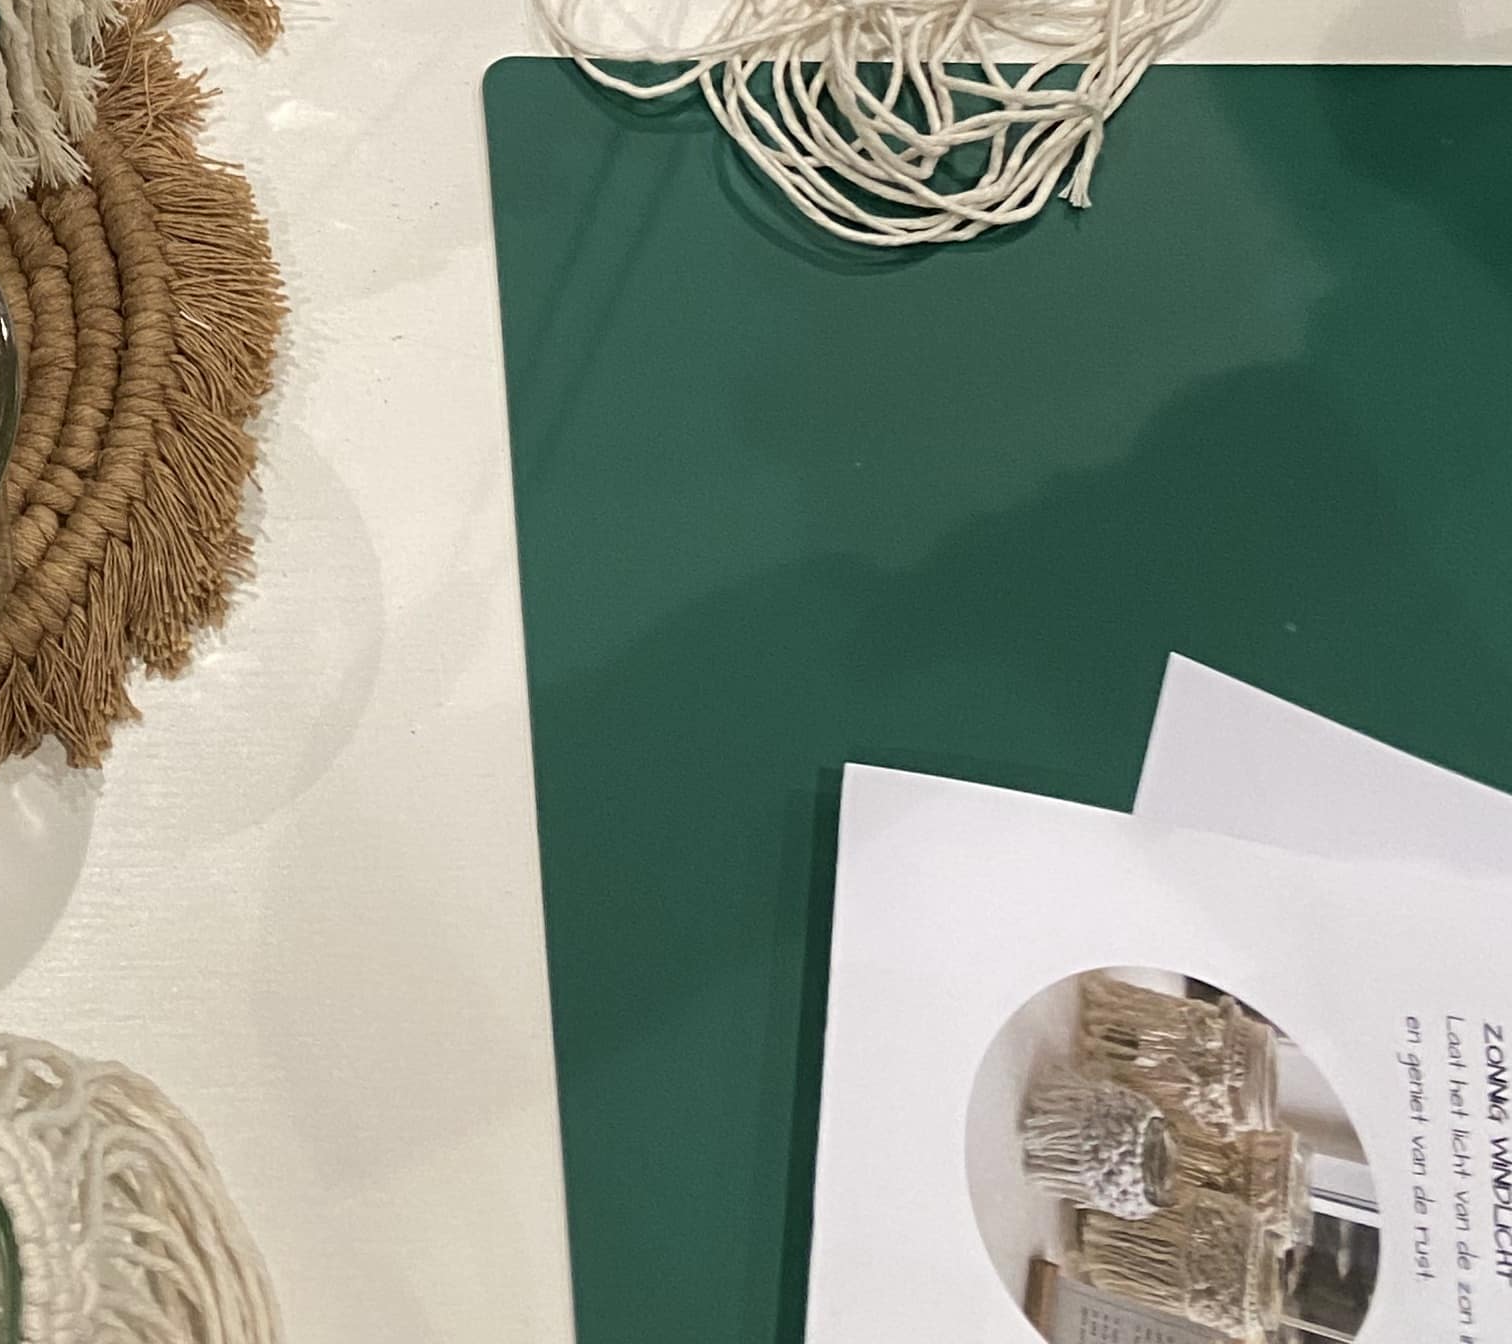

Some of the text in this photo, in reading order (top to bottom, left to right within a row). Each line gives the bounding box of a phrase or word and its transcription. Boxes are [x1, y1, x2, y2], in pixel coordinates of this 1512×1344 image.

[1405, 1015, 1422, 1044] en
[1446, 1015, 1467, 1069] Laat
[1396, 1052, 1429, 1122] geniet
[1484, 1022, 1510, 1122] ZONNIG
[1449, 1079, 1470, 1116] het
[1412, 1135, 1428, 1176] van
[1452, 1128, 1472, 1178] licht
[1413, 1185, 1436, 1215] de
[1454, 1190, 1471, 1231] van
[1457, 1240, 1480, 1271] de
[1458, 1280, 1475, 1325] zon
